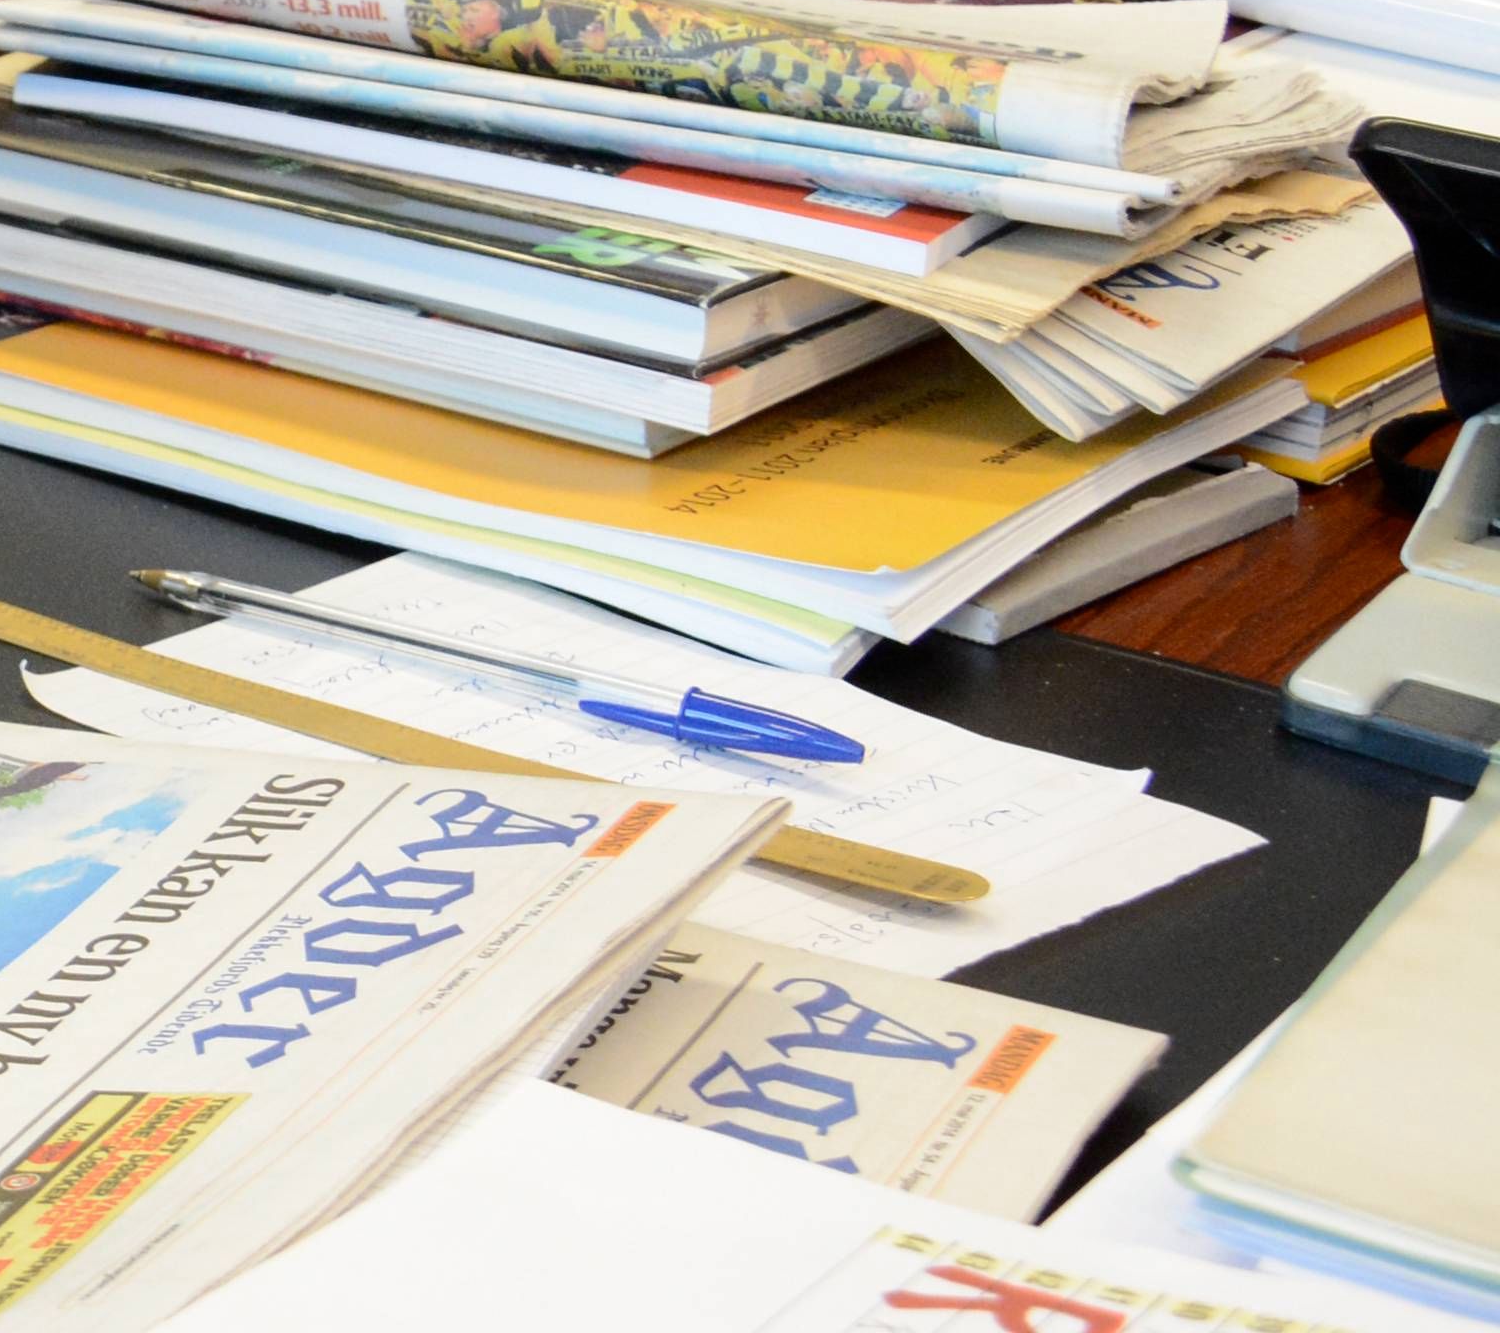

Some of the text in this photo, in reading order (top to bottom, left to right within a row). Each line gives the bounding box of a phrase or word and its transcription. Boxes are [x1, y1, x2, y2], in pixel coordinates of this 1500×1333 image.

[629, 64, 674, 80] VIKING
[194, 773, 354, 854] Slik
[102, 842, 274, 934] kan
[52, 929, 155, 987] en
[190, 786, 600, 1068] Agder
[968, 1025, 1054, 1094] MANDAG
[126, 1094, 193, 1140] VARME
[150, 1094, 240, 1155] TRELAST
[29, 1143, 121, 1206] KJØKKEN
[84, 1152, 153, 1198] DØRER
